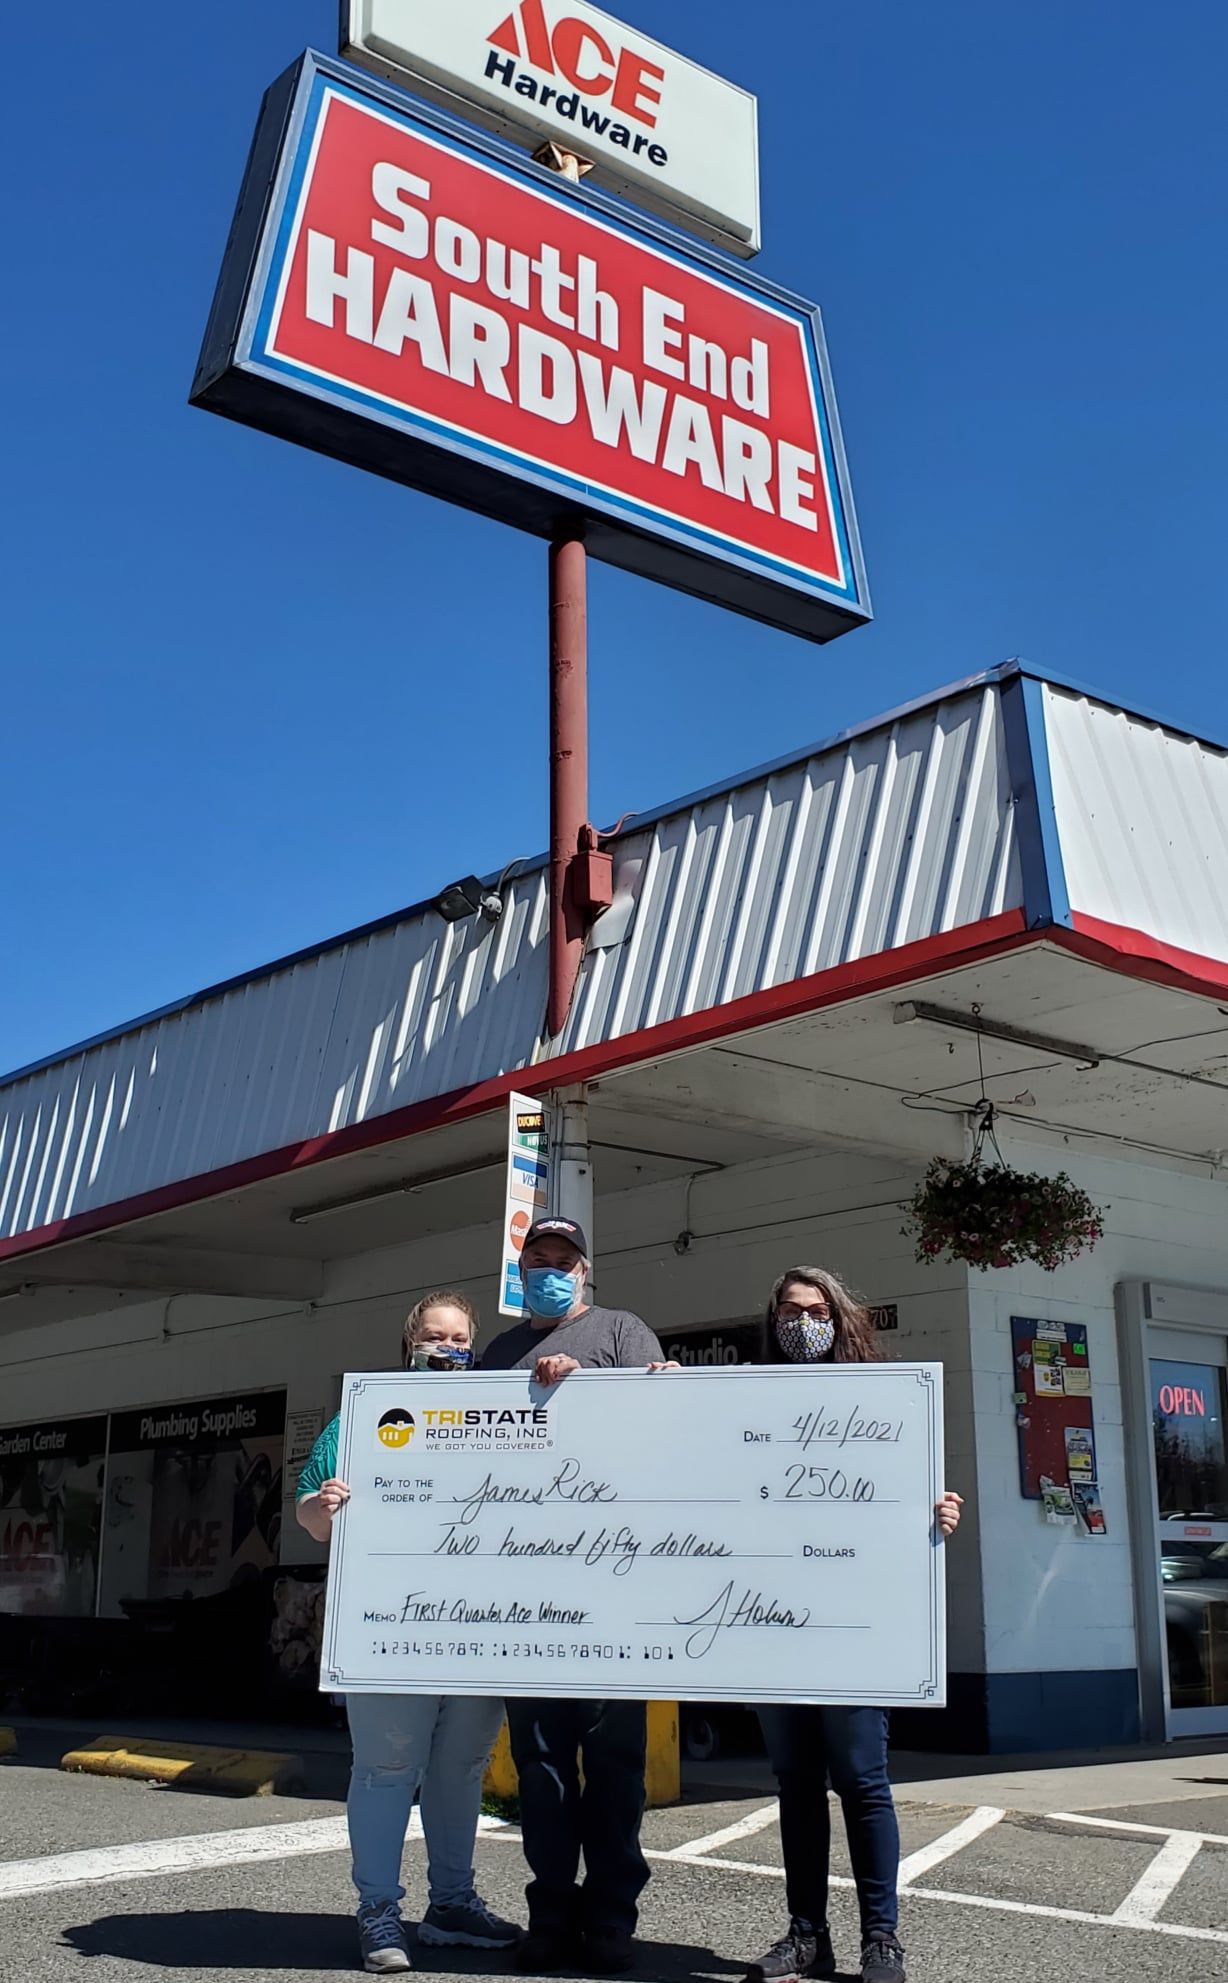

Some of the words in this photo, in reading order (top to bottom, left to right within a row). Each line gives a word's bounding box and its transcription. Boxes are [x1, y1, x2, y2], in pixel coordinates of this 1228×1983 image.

[486, 0, 665, 129] ACE
[484, 50, 668, 167] Hardware
[371, 161, 619, 351] South
[643, 285, 770, 420] End
[305, 228, 819, 532] HARDWARE
[522, 1172, 539, 1189] VISA
[668, 1337, 738, 1365] Studio
[1159, 1385, 1206, 1416] OPEN
[140, 1412, 199, 1440] Plumbing
[202, 1404, 257, 1436] Supplies
[422, 1409, 548, 1426] TRISTATE
[792, 1405, 903, 1451] 4/12/2021
[33, 1430, 67, 1450] Center
[425, 1427, 511, 1441] ROOFING,
[744, 1431, 771, 1443] DATE
[426, 1443, 441, 1451] WE
[445, 1443, 466, 1451] GOT
[470, 1443, 491, 1451] YOU
[374, 1477, 394, 1488] PAY
[398, 1479, 411, 1488] TO
[415, 1479, 434, 1488] THE
[453, 1472, 545, 1524] James
[546, 1458, 618, 1503] Rick
[760, 1485, 769, 1500] $
[784, 1463, 875, 1503] 250.00
[382, 1493, 415, 1503] ORDER
[419, 1493, 433, 1503] OF
[159, 1516, 221, 1567] ACE
[434, 1521, 481, 1555] Two
[498, 1527, 585, 1557] hundred
[585, 1527, 641, 1576] fifty
[649, 1532, 732, 1558] dollars
[803, 1545, 856, 1558] DOLLARS
[363, 1611, 397, 1623] MEMO
[505, 1601, 531, 1624] Ace
[538, 1601, 592, 1624] Winner
